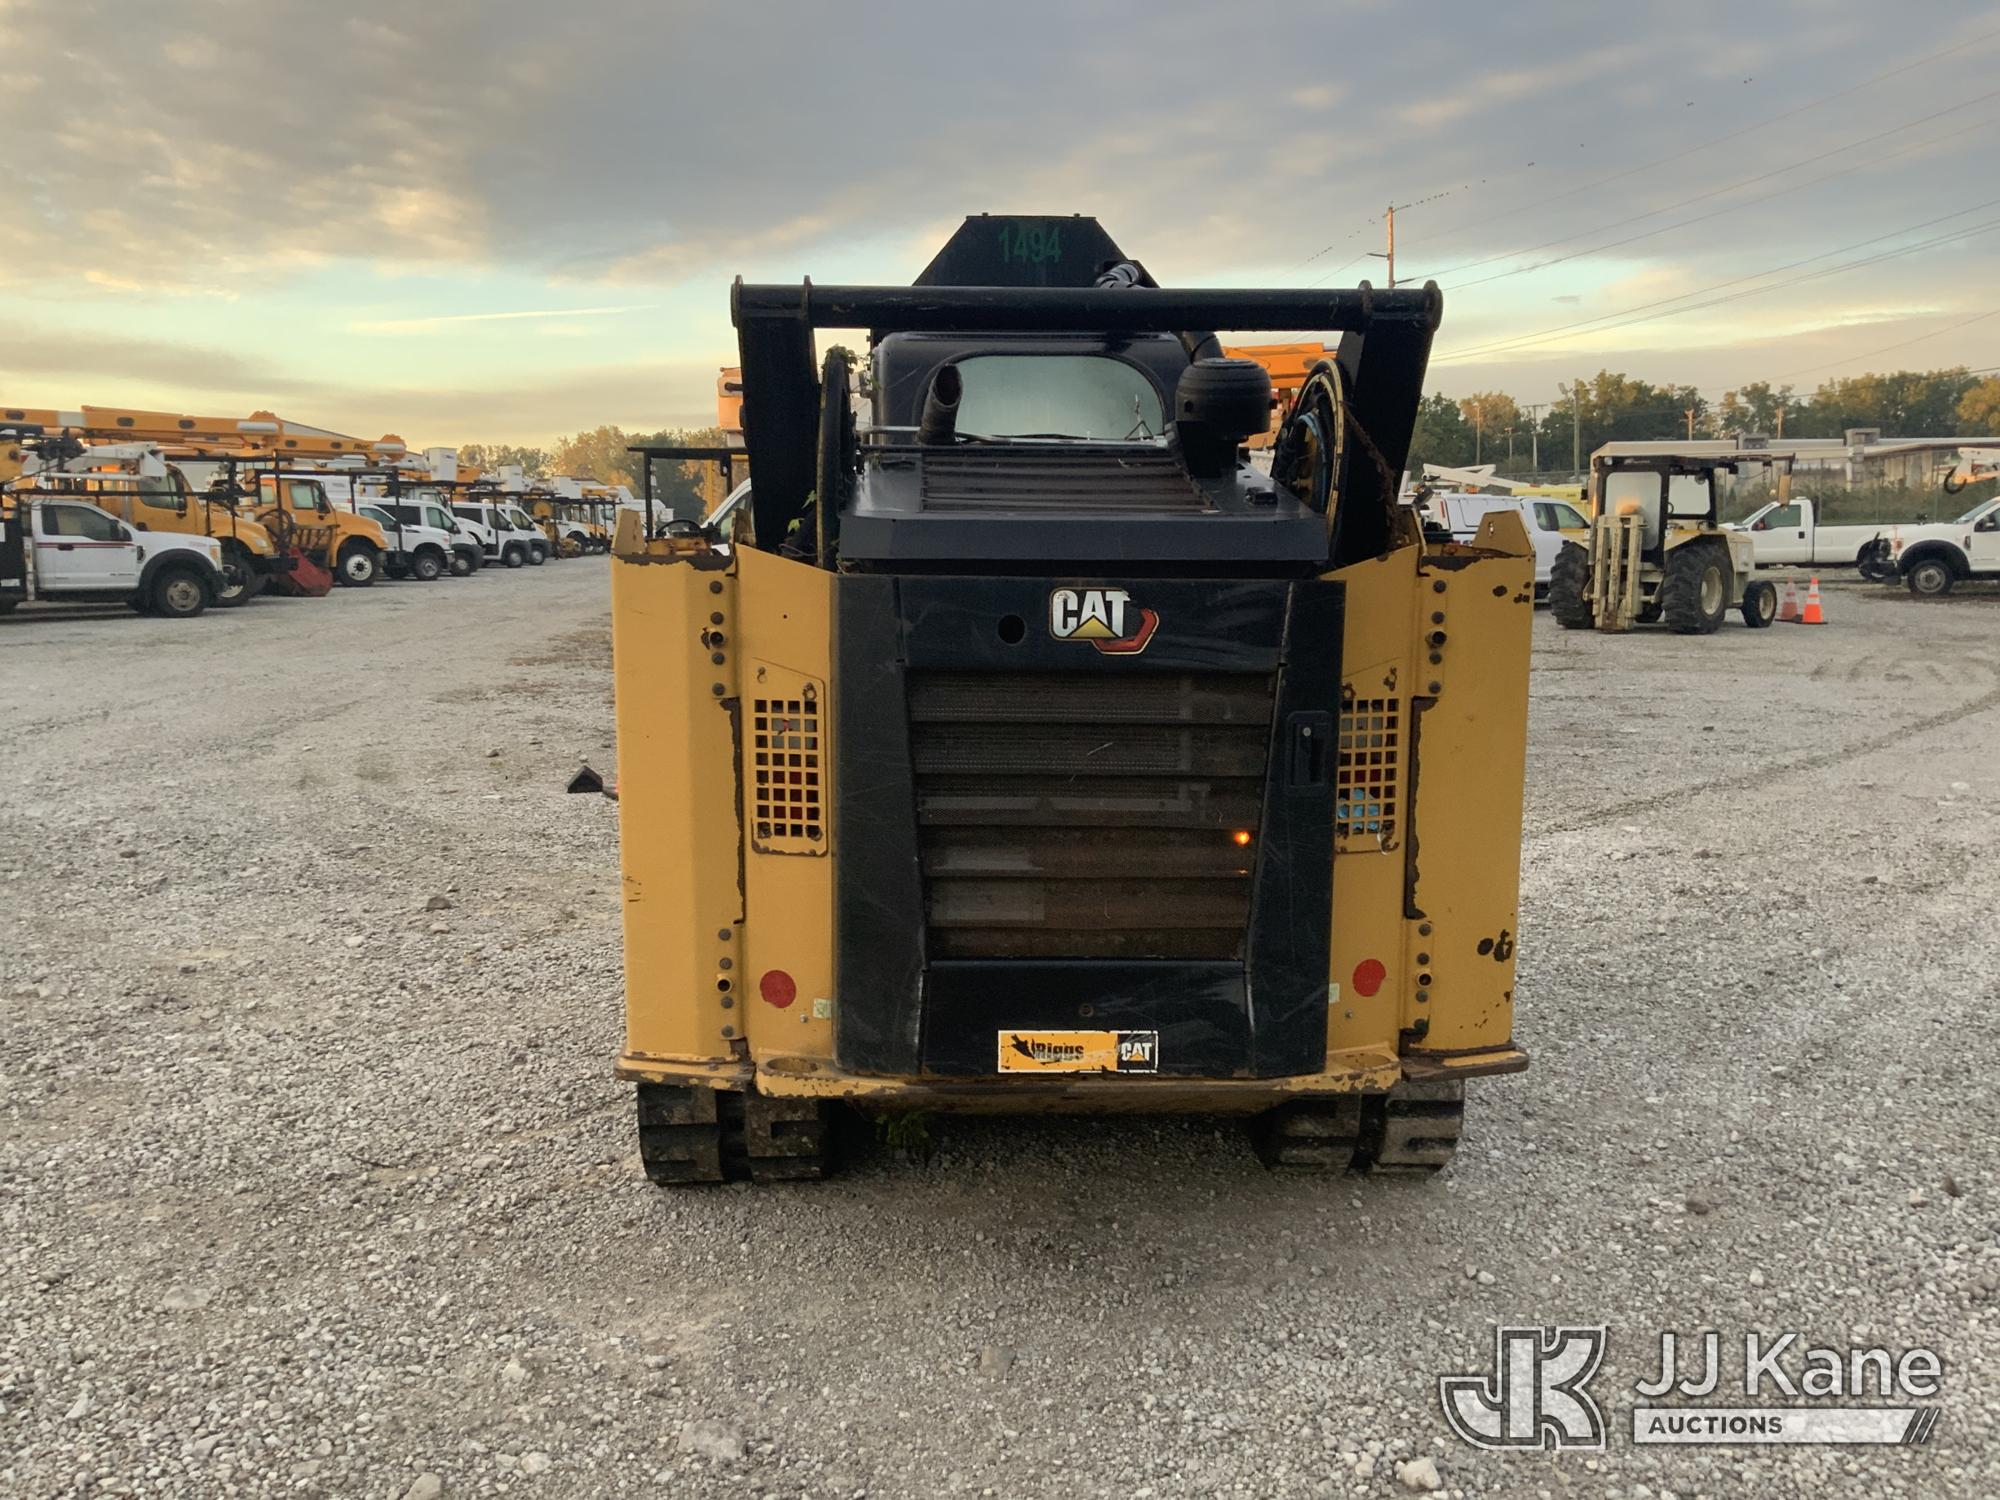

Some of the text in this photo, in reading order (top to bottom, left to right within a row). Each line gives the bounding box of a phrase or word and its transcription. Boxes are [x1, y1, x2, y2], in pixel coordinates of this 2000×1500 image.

[998, 226, 1062, 263] 1494
[1052, 589, 1131, 638] CAT
[1121, 1042, 1154, 1062] CAT
